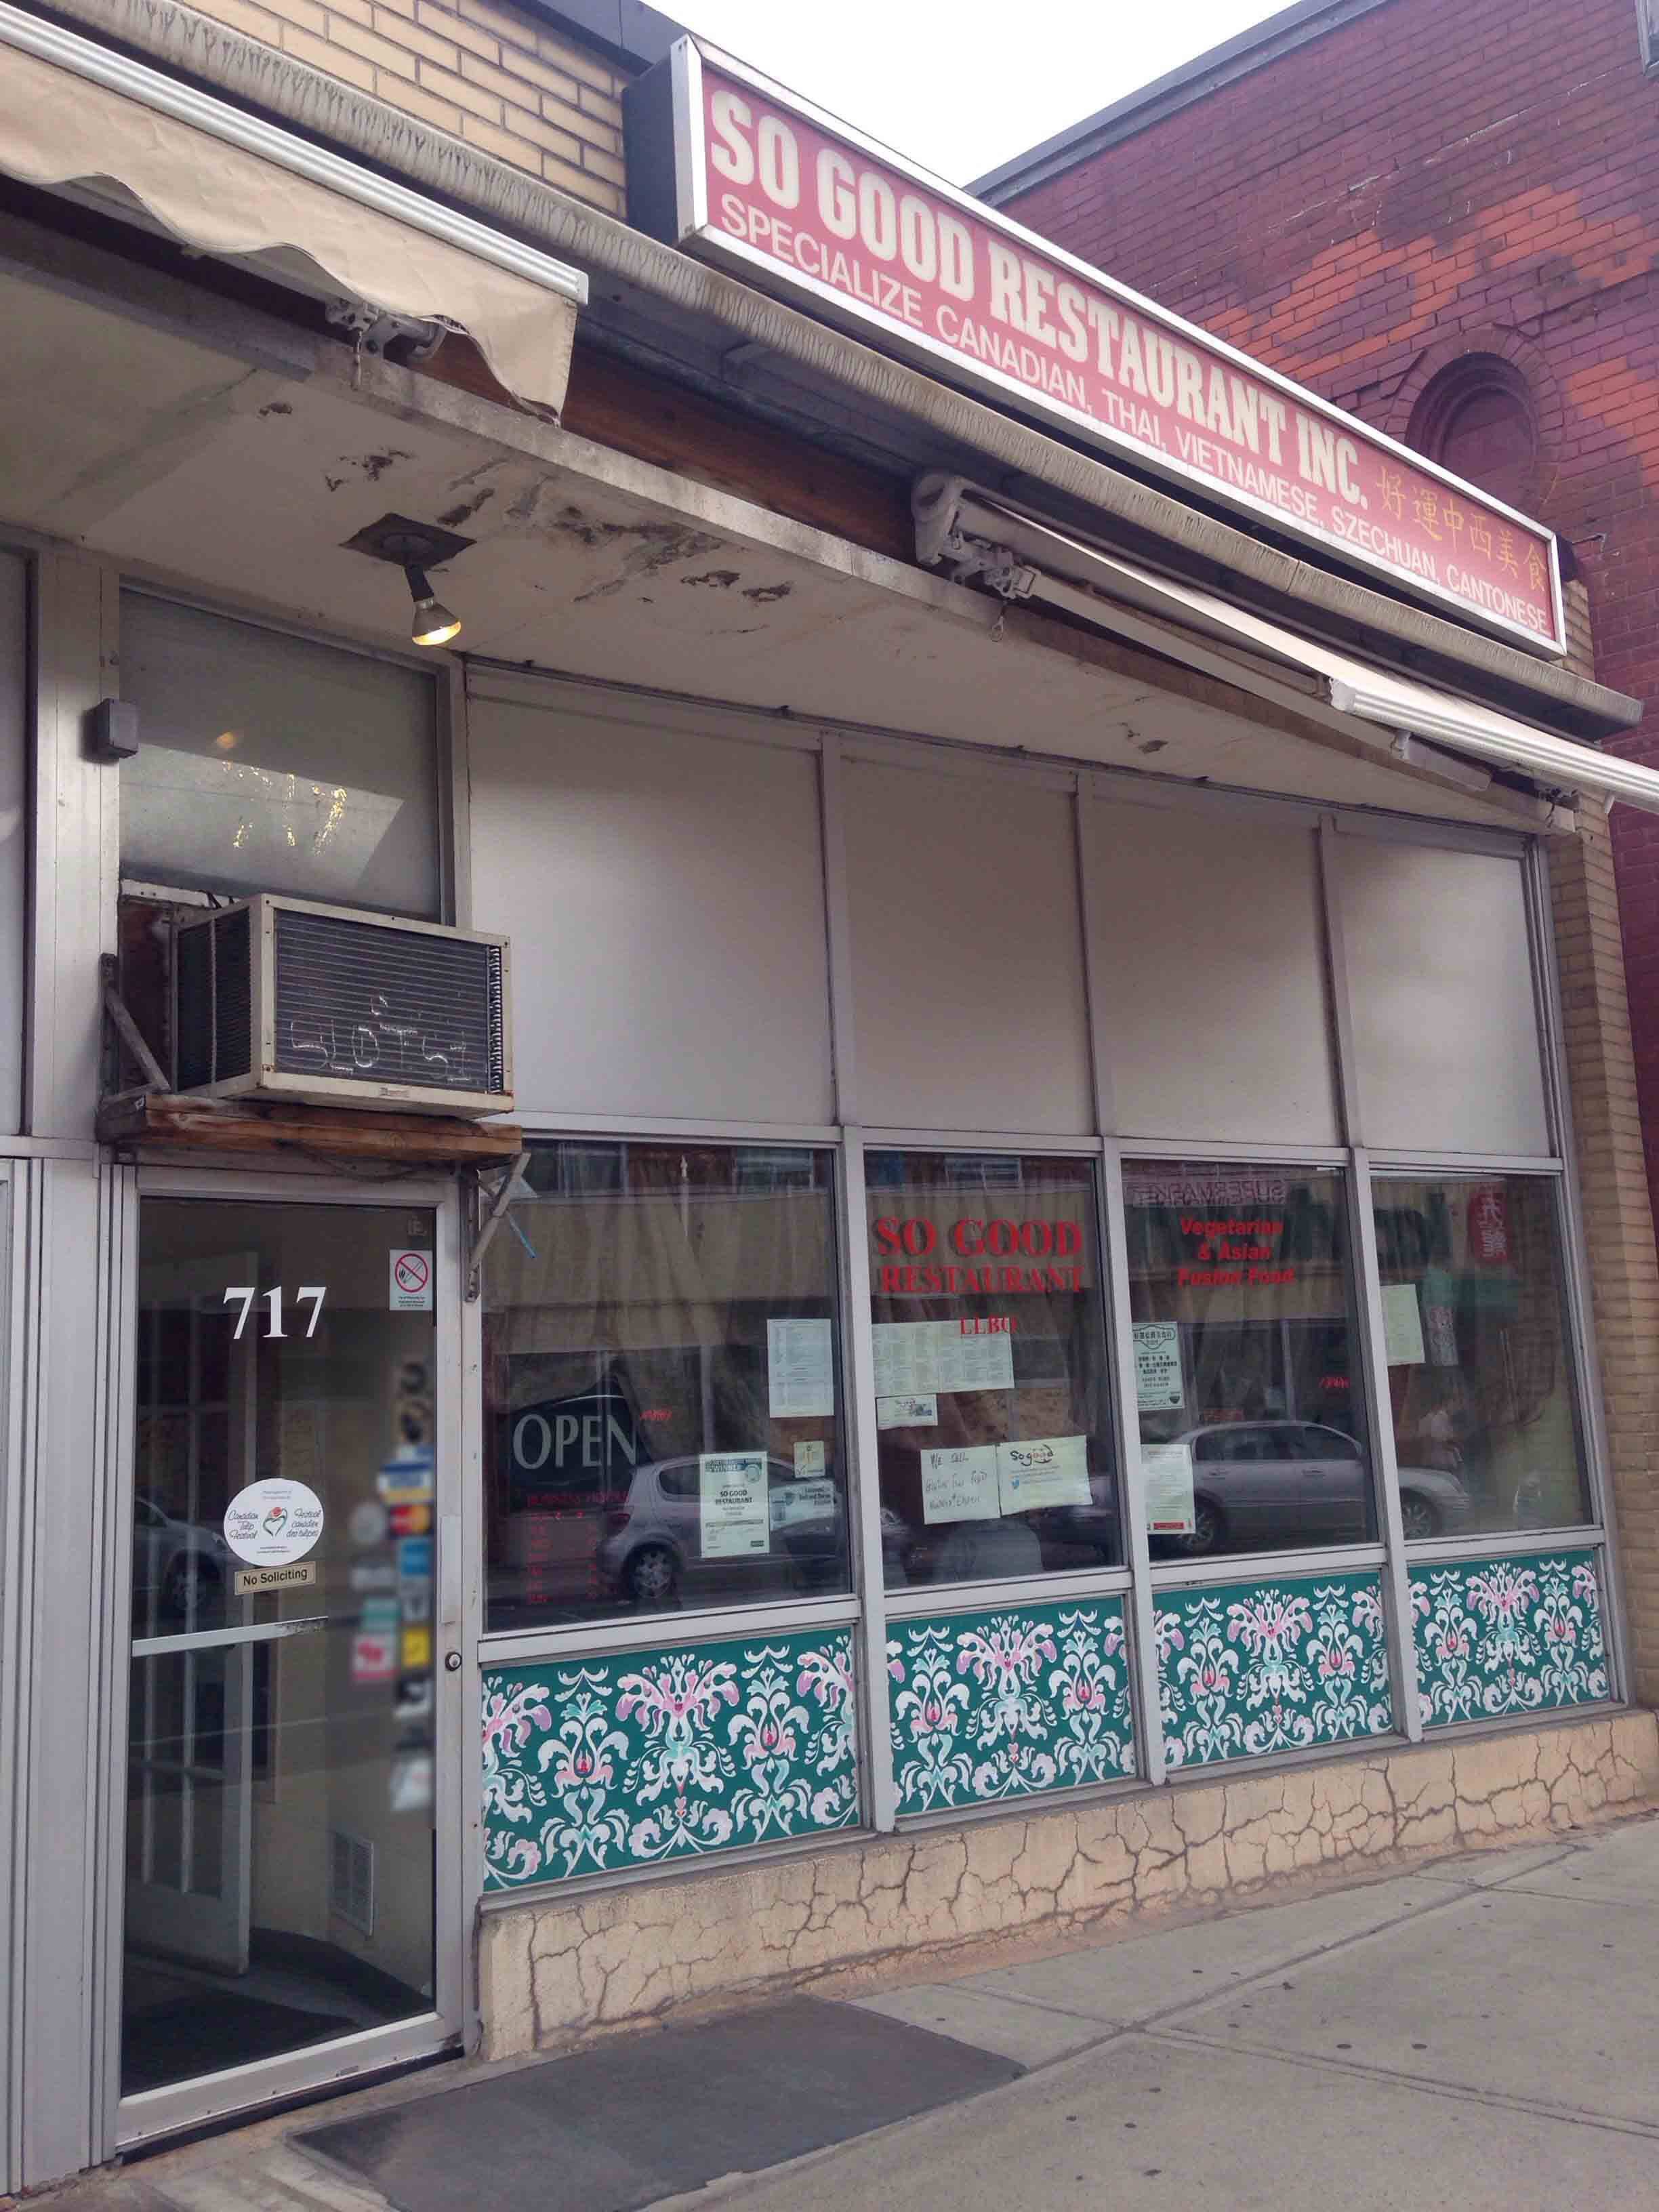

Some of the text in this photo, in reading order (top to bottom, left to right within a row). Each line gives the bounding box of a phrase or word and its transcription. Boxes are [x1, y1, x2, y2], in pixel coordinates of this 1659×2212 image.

[710, 89, 1368, 510] SO GOOD RESTAURANT INC.
[720, 192, 924, 328] SPECIALIZE
[1446, 564, 1546, 634] CANTONESE
[876, 1216, 1083, 1258] SO GOOD
[881, 1264, 1086, 1294] RESTAURANT
[222, 1286, 327, 1340] 717
[512, 1413, 637, 1471] OPEN
[243, 1568, 308, 1586] No Soliciting
